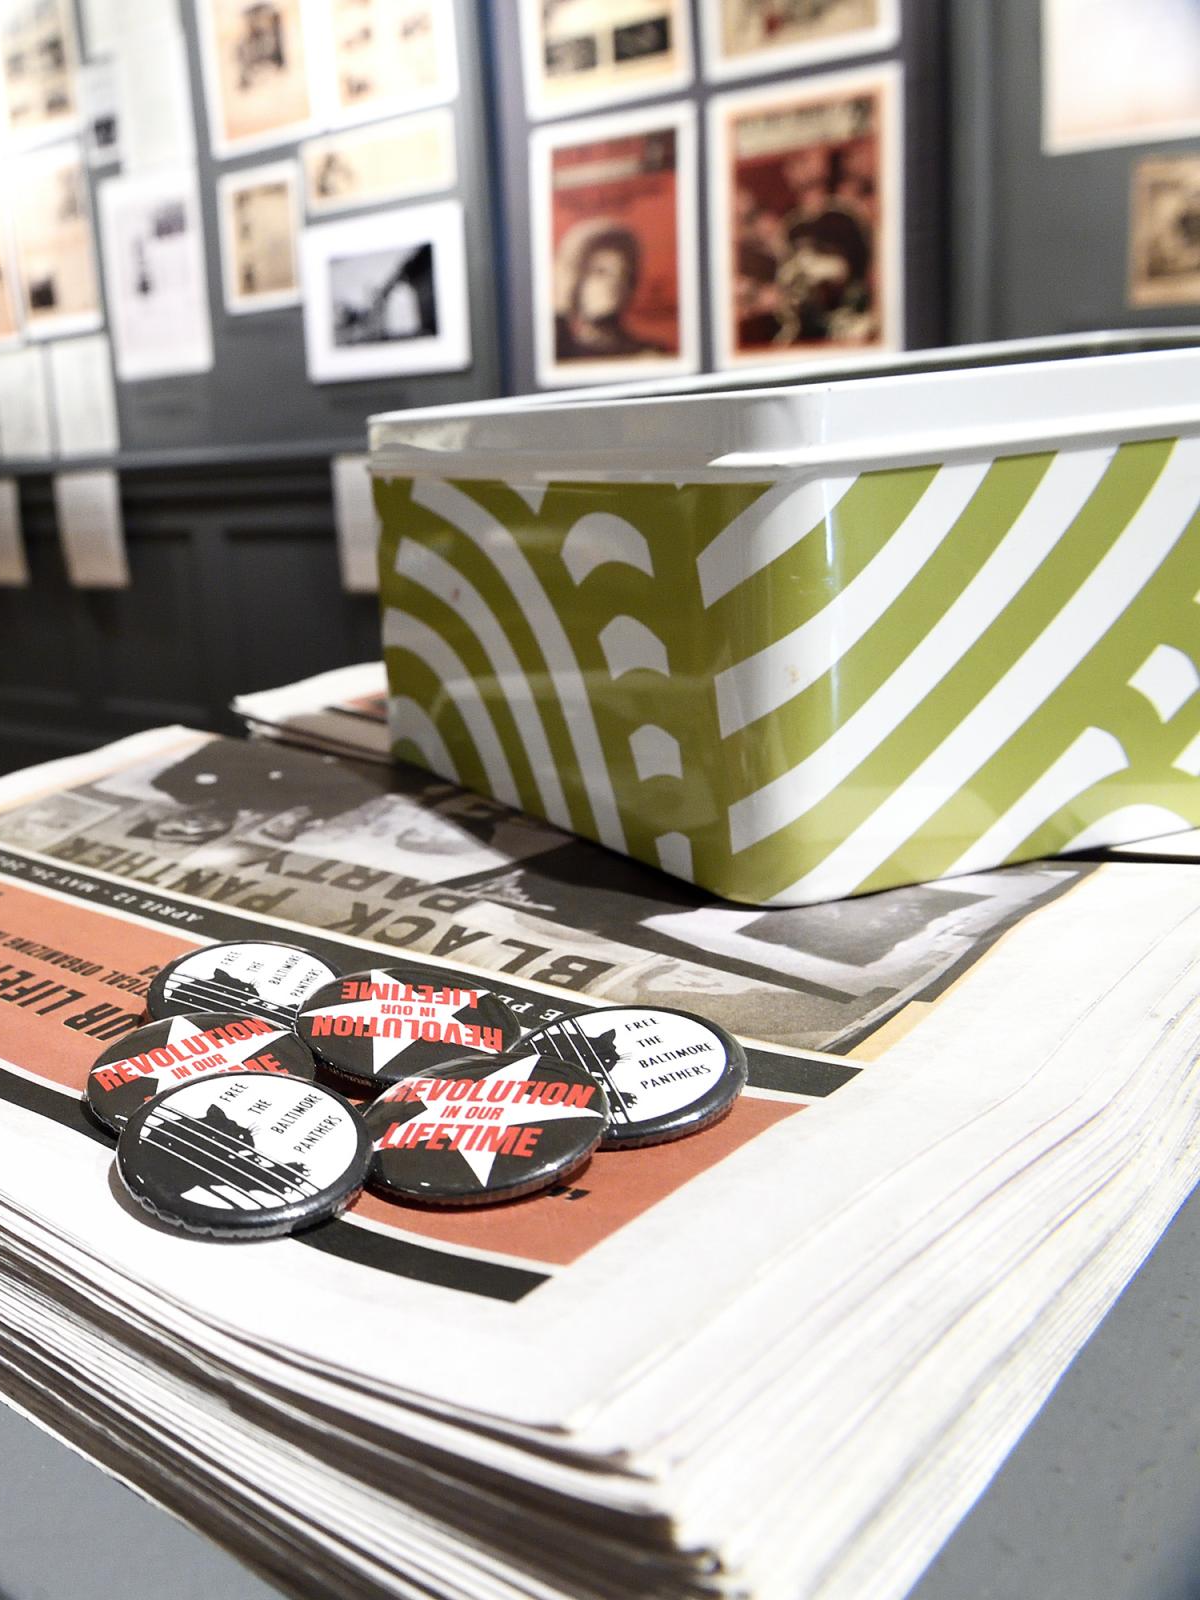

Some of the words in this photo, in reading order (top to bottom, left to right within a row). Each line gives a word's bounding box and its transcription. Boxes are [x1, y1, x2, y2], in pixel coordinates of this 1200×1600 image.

[38, 838, 297, 916] PANTHER
[113, 892, 137, 905] 12
[140, 900, 204, 923] APRIL
[2, 937, 104, 976] ORGANIZING
[220, 950, 243, 966] FREE
[327, 902, 619, 991] BLACK
[246, 960, 265, 973] THE
[268, 954, 303, 986] BALTIMORE
[99, 969, 149, 998] TICAL
[290, 968, 323, 998] PANTHERS
[341, 981, 478, 1009] LIFETIME
[63, 1002, 144, 1041] UR
[380, 1004, 413, 1016] OUR
[419, 1006, 436, 1017] IN
[311, 1014, 504, 1052] REVOLUTION
[624, 1017, 660, 1031] FREE
[94, 1017, 273, 1092] REVOLUTION
[636, 1034, 664, 1048] THE
[170, 1064, 191, 1080] IN
[193, 1053, 228, 1071] OUR
[638, 1042, 715, 1069] BALTIMORE
[640, 1064, 712, 1090] PANTHERS
[219, 1082, 248, 1102] FREE
[383, 1078, 596, 1109] REVOLUTION
[248, 1099, 272, 1115] THE
[270, 1093, 323, 1134] BALTIMORE
[440, 1105, 458, 1119] IN
[464, 1106, 504, 1120] OUR
[293, 1115, 342, 1154] PANTHERS
[380, 1122, 544, 1158] LIFETIME
